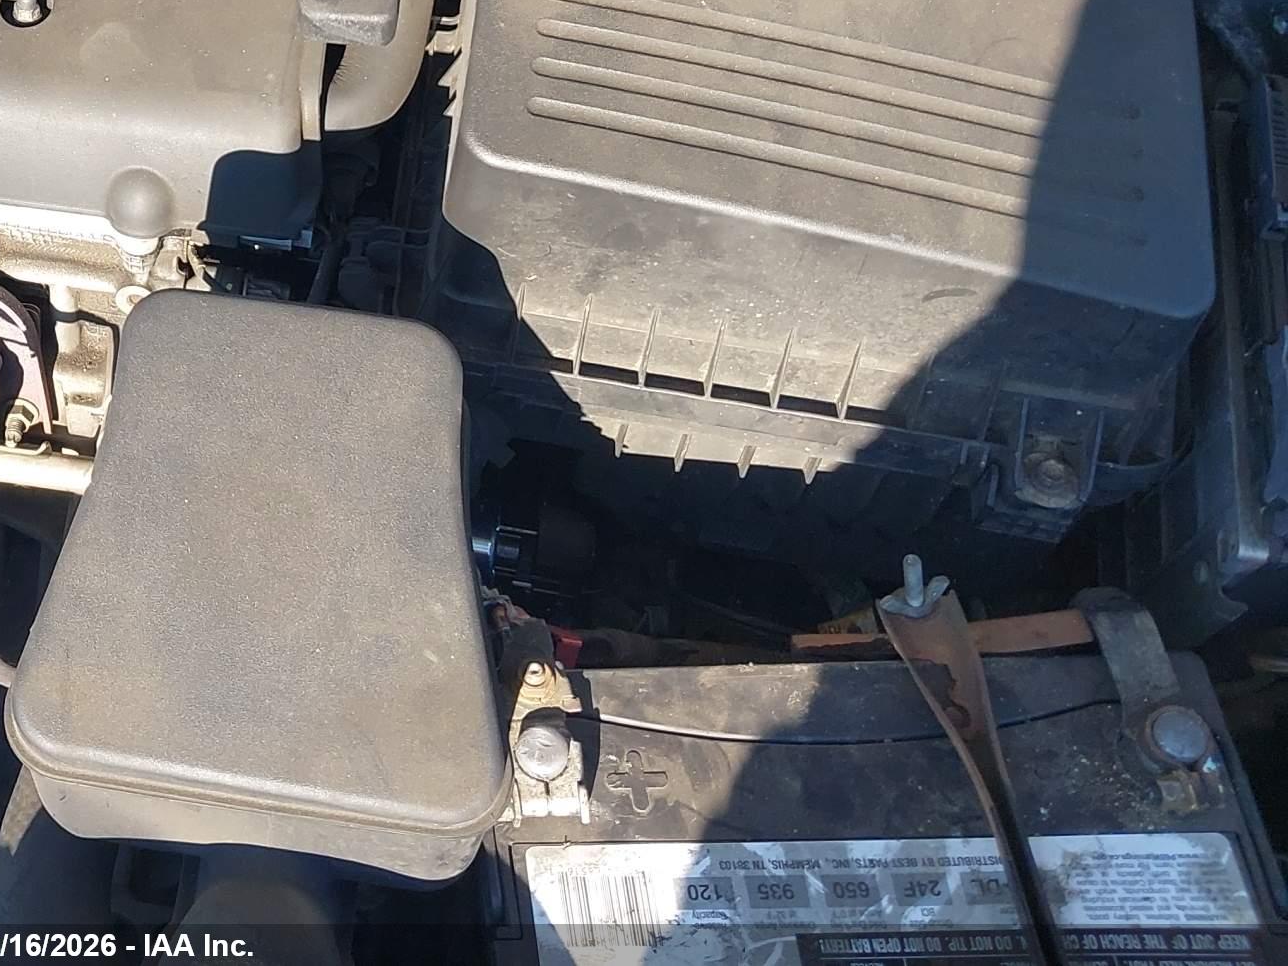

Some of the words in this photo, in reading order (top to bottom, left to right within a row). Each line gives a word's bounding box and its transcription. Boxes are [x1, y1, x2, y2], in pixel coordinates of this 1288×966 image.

[719, 859, 750, 871] 38103
[751, 859, 766, 871] TN
[890, 856, 918, 870] BEST
[920, 856, 935, 869] BY
[937, 855, 1002, 869] ISTRIBUTED
[687, 883, 723, 902] 120
[757, 882, 796, 901] 935
[832, 881, 871, 900] 650
[903, 879, 943, 899] 24F
[818, 938, 871, 954] BATTERY!
[871, 937, 902, 953] OPEN
[902, 936, 924, 952] NOT
[924, 936, 942, 952] DO
[967, 935, 993, 952] NOT
[993, 934, 1012, 951] DO
[1080, 934, 1097, 951] OF
[1099, 933, 1140, 951] REACH
[1144, 933, 1168, 950] THE
[1170, 933, 1188, 950] OF
[1189, 933, 1215, 950] OUT
[1217, 933, 1249, 950] KEEP
